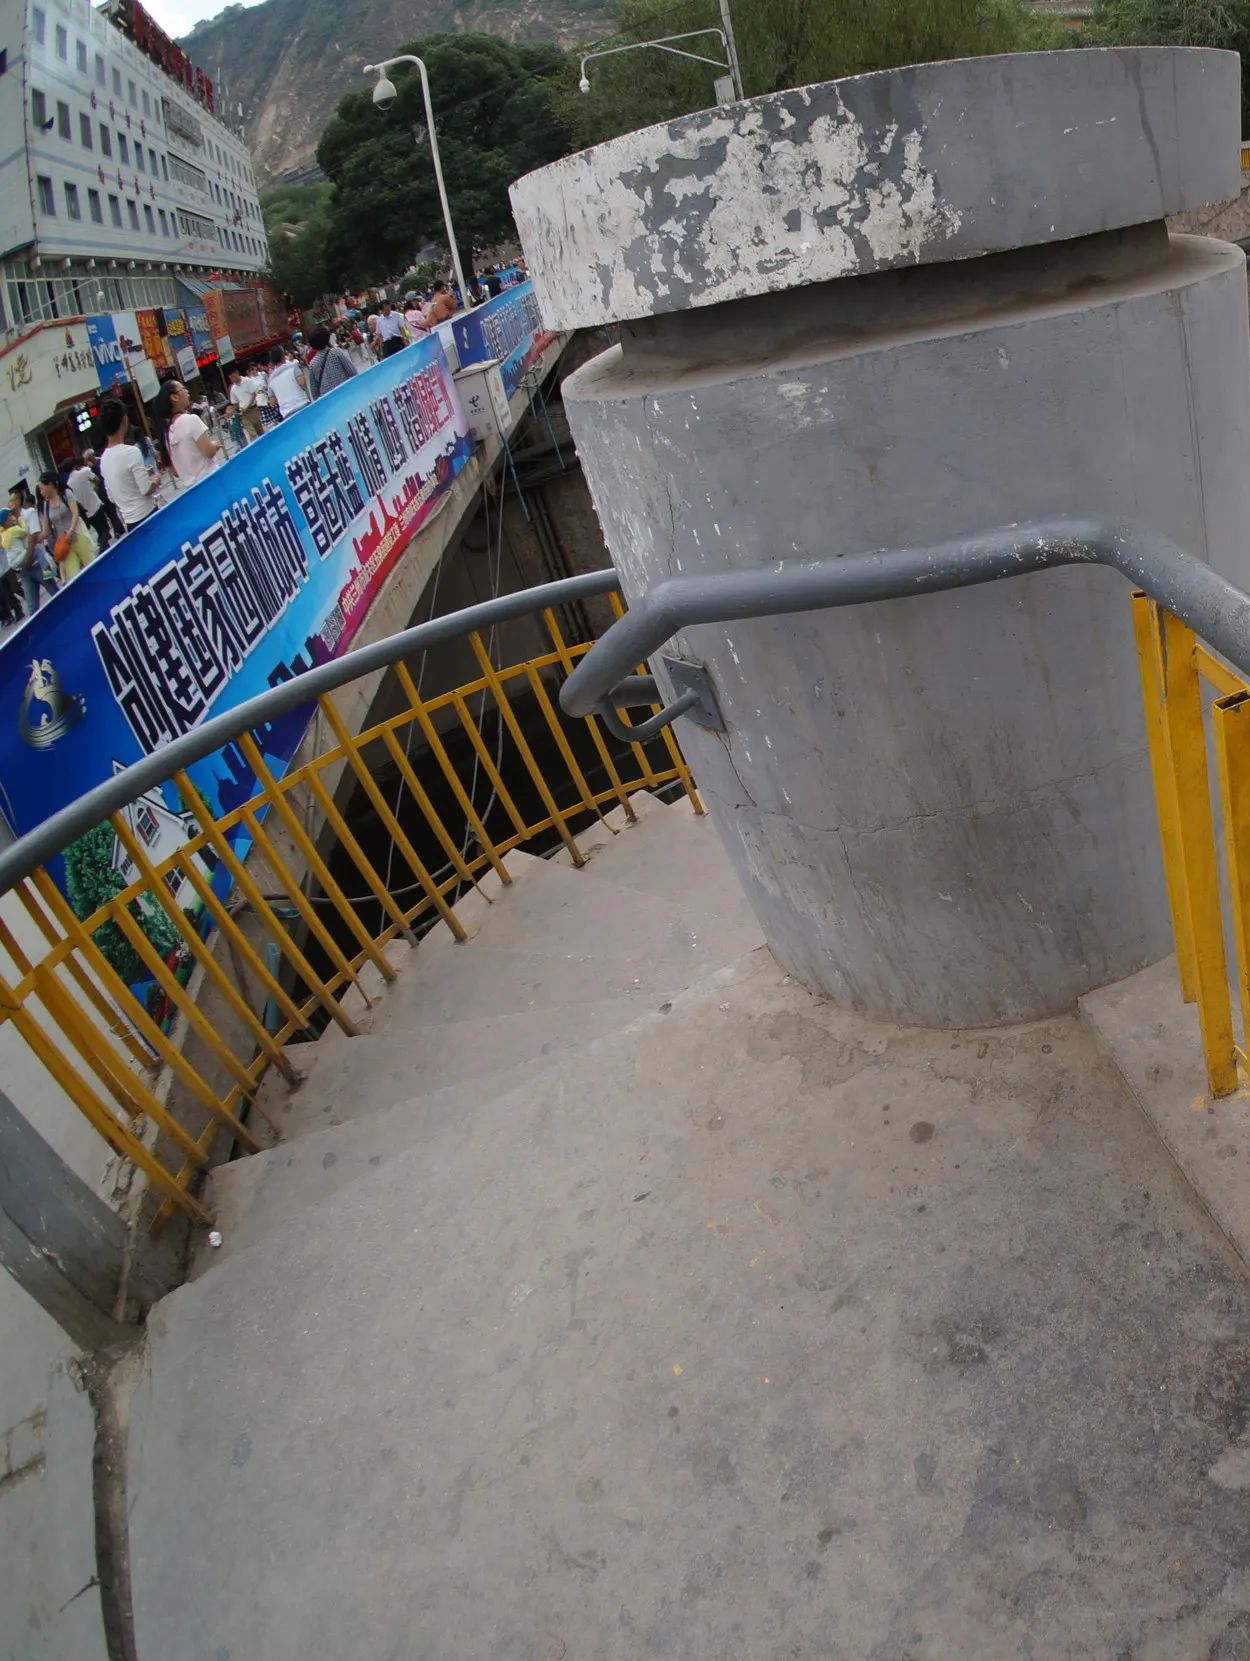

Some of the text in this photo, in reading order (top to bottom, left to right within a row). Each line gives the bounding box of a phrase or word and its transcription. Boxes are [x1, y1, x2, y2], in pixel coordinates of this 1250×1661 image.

[91, 475, 310, 756] 创建国家园林城市
